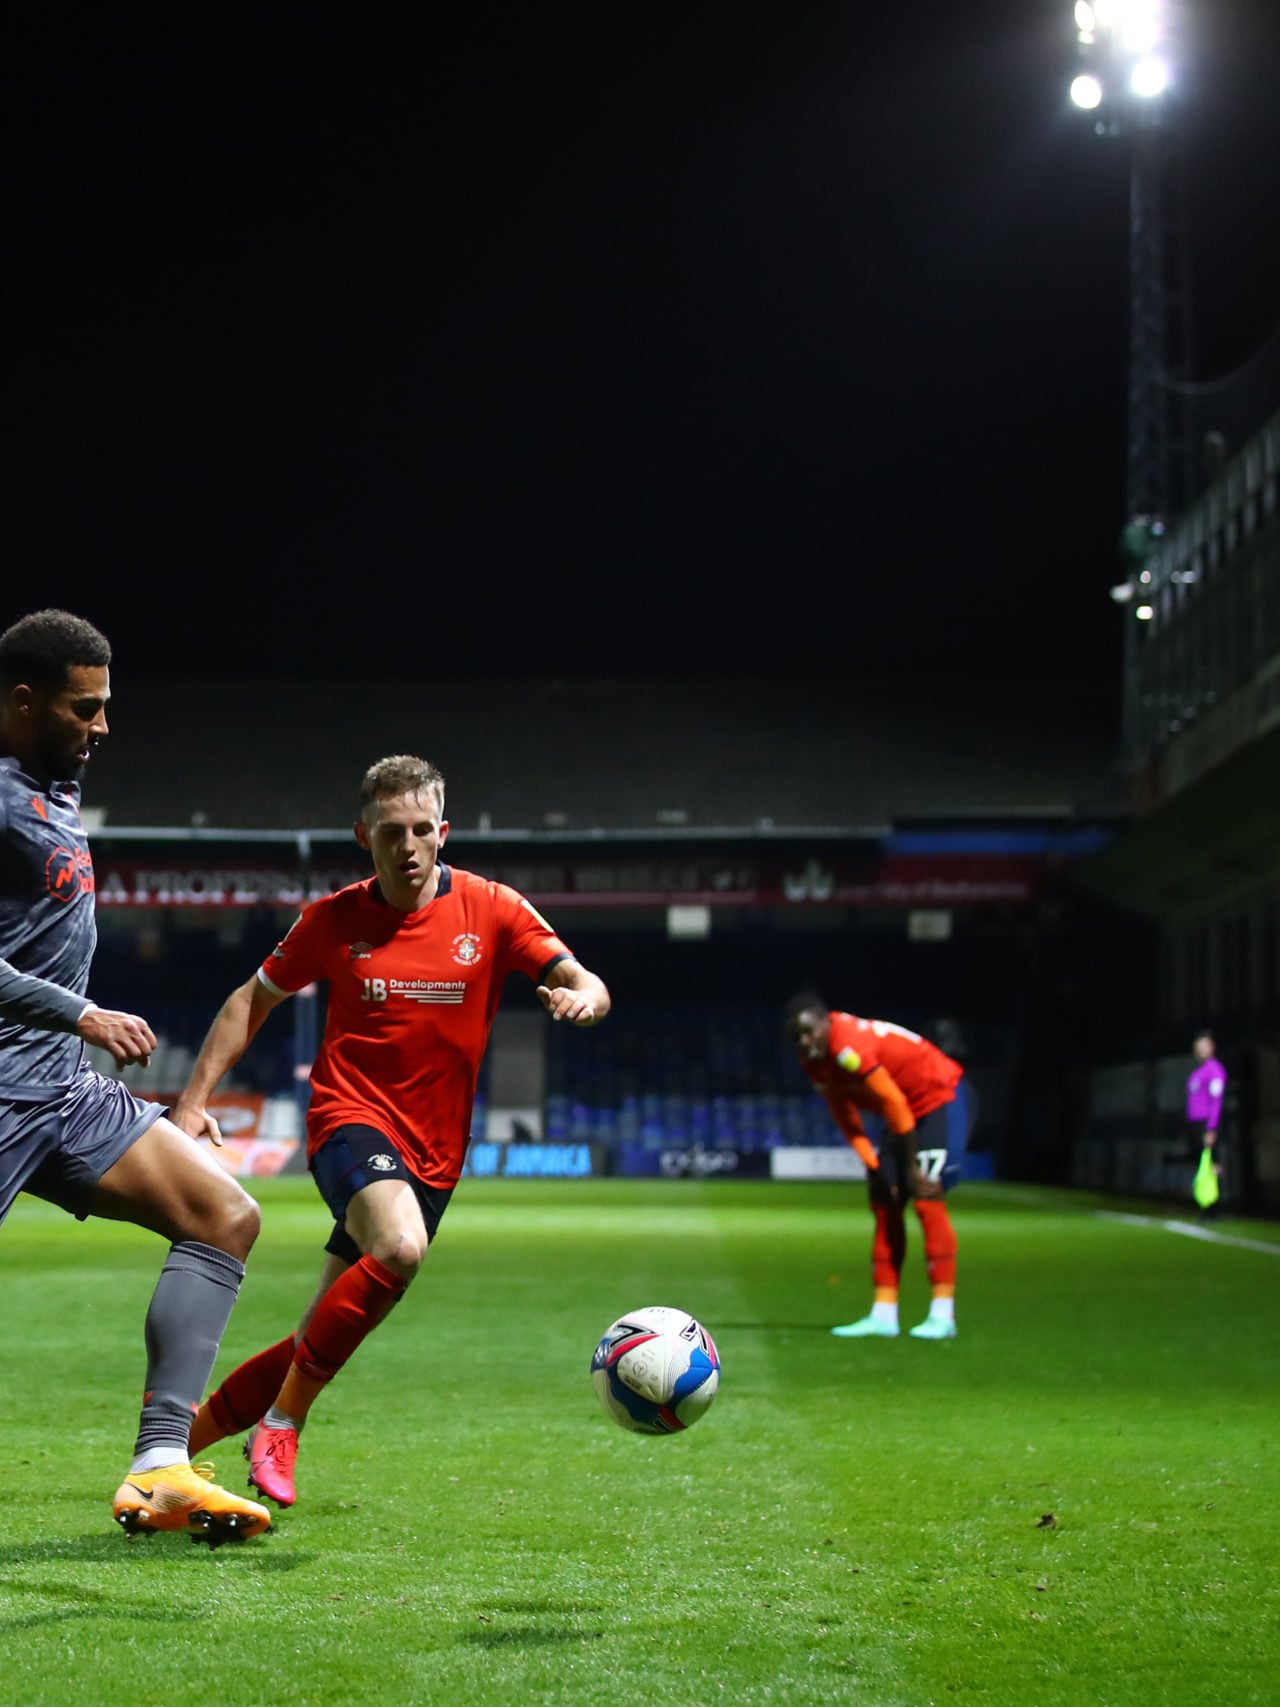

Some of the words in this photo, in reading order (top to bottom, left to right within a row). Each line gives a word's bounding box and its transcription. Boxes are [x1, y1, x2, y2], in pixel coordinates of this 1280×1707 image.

[361, 978, 387, 1001] JB
[390, 978, 466, 991] Developments
[916, 1149, 948, 1182] 17
